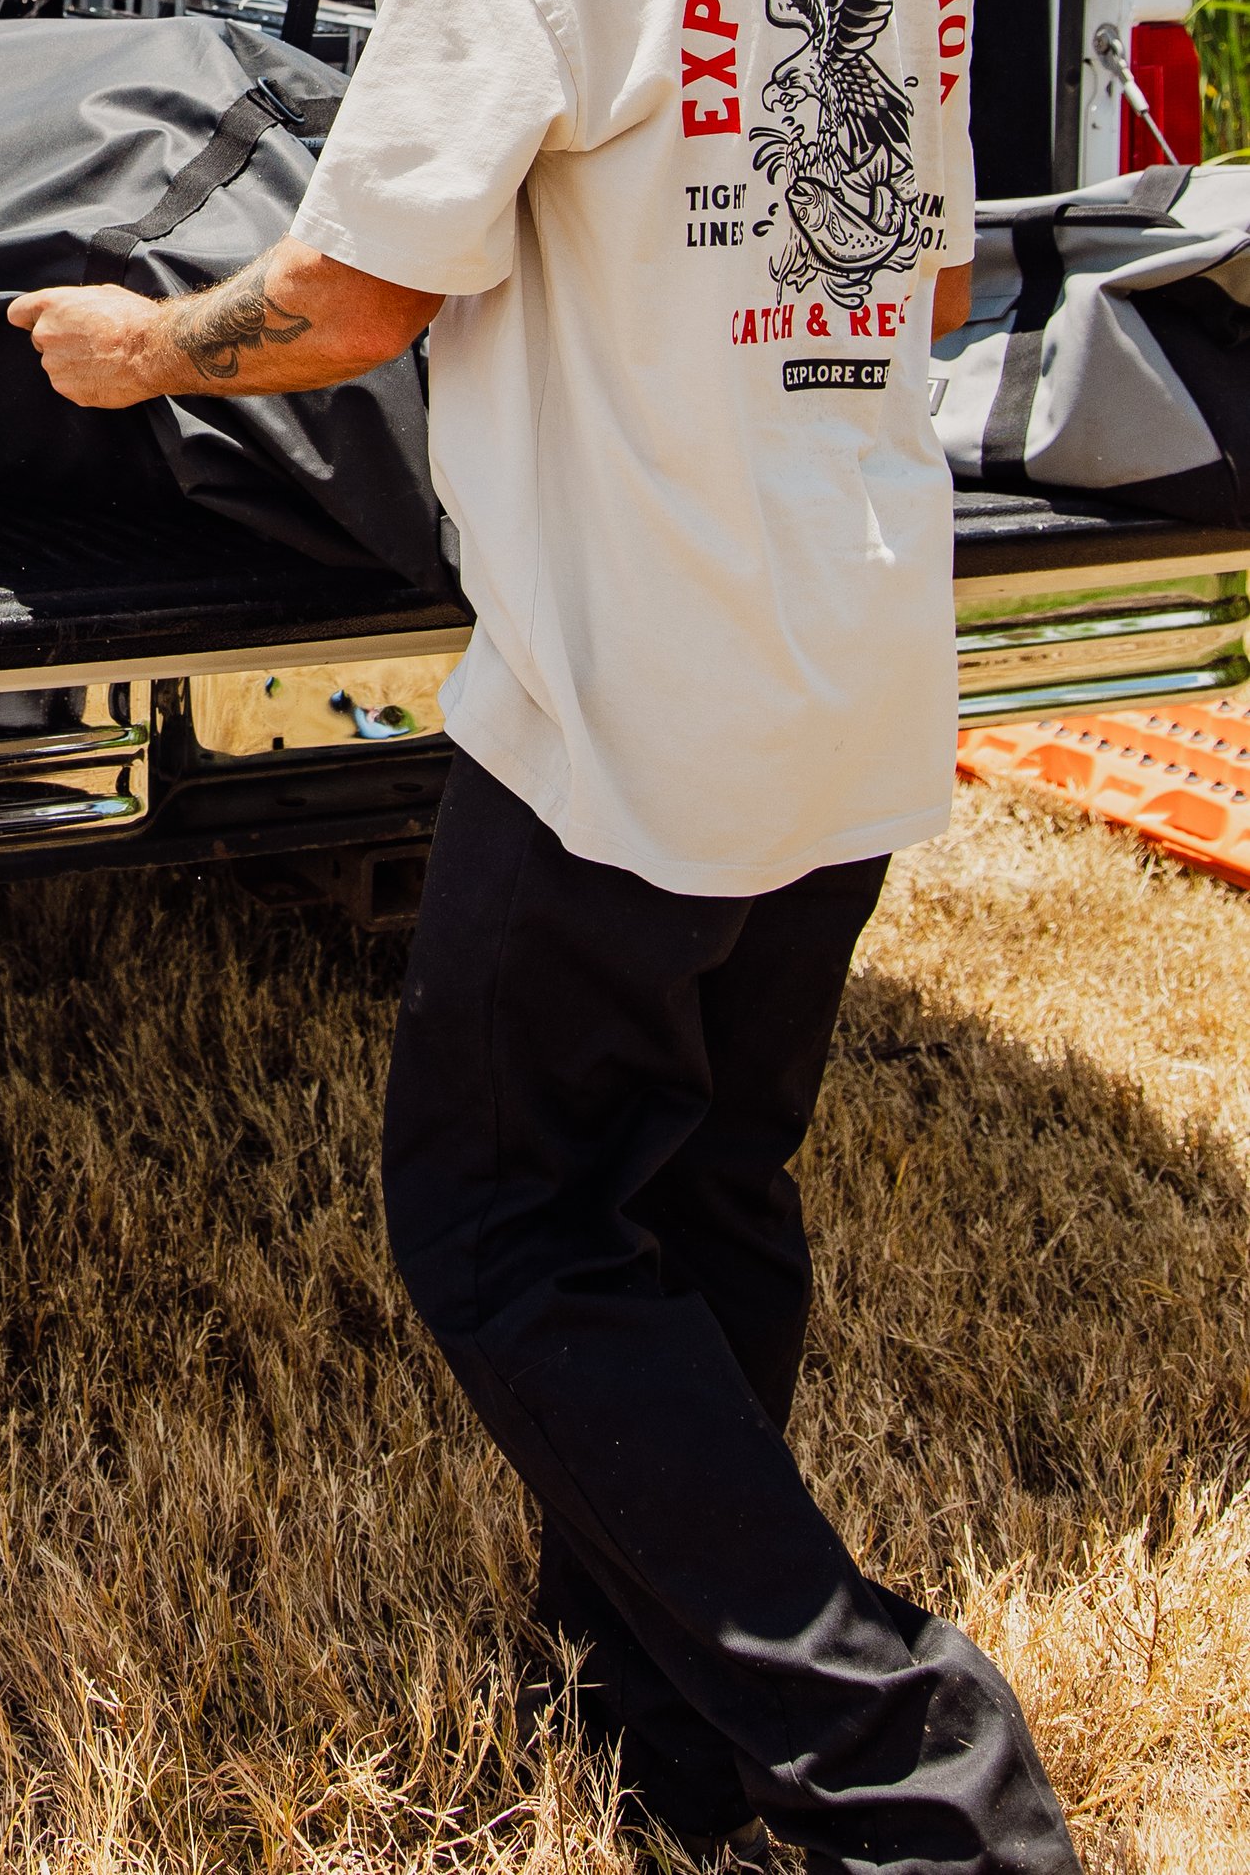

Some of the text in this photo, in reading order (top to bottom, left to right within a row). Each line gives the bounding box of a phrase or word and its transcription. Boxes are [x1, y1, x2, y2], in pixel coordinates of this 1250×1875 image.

[686, 183, 747, 211] TIGHT
[686, 220, 744, 248] LINES
[732, 303, 795, 346] CATCH
[806, 302, 832, 338] &
[786, 365, 855, 386] EXPLORE
